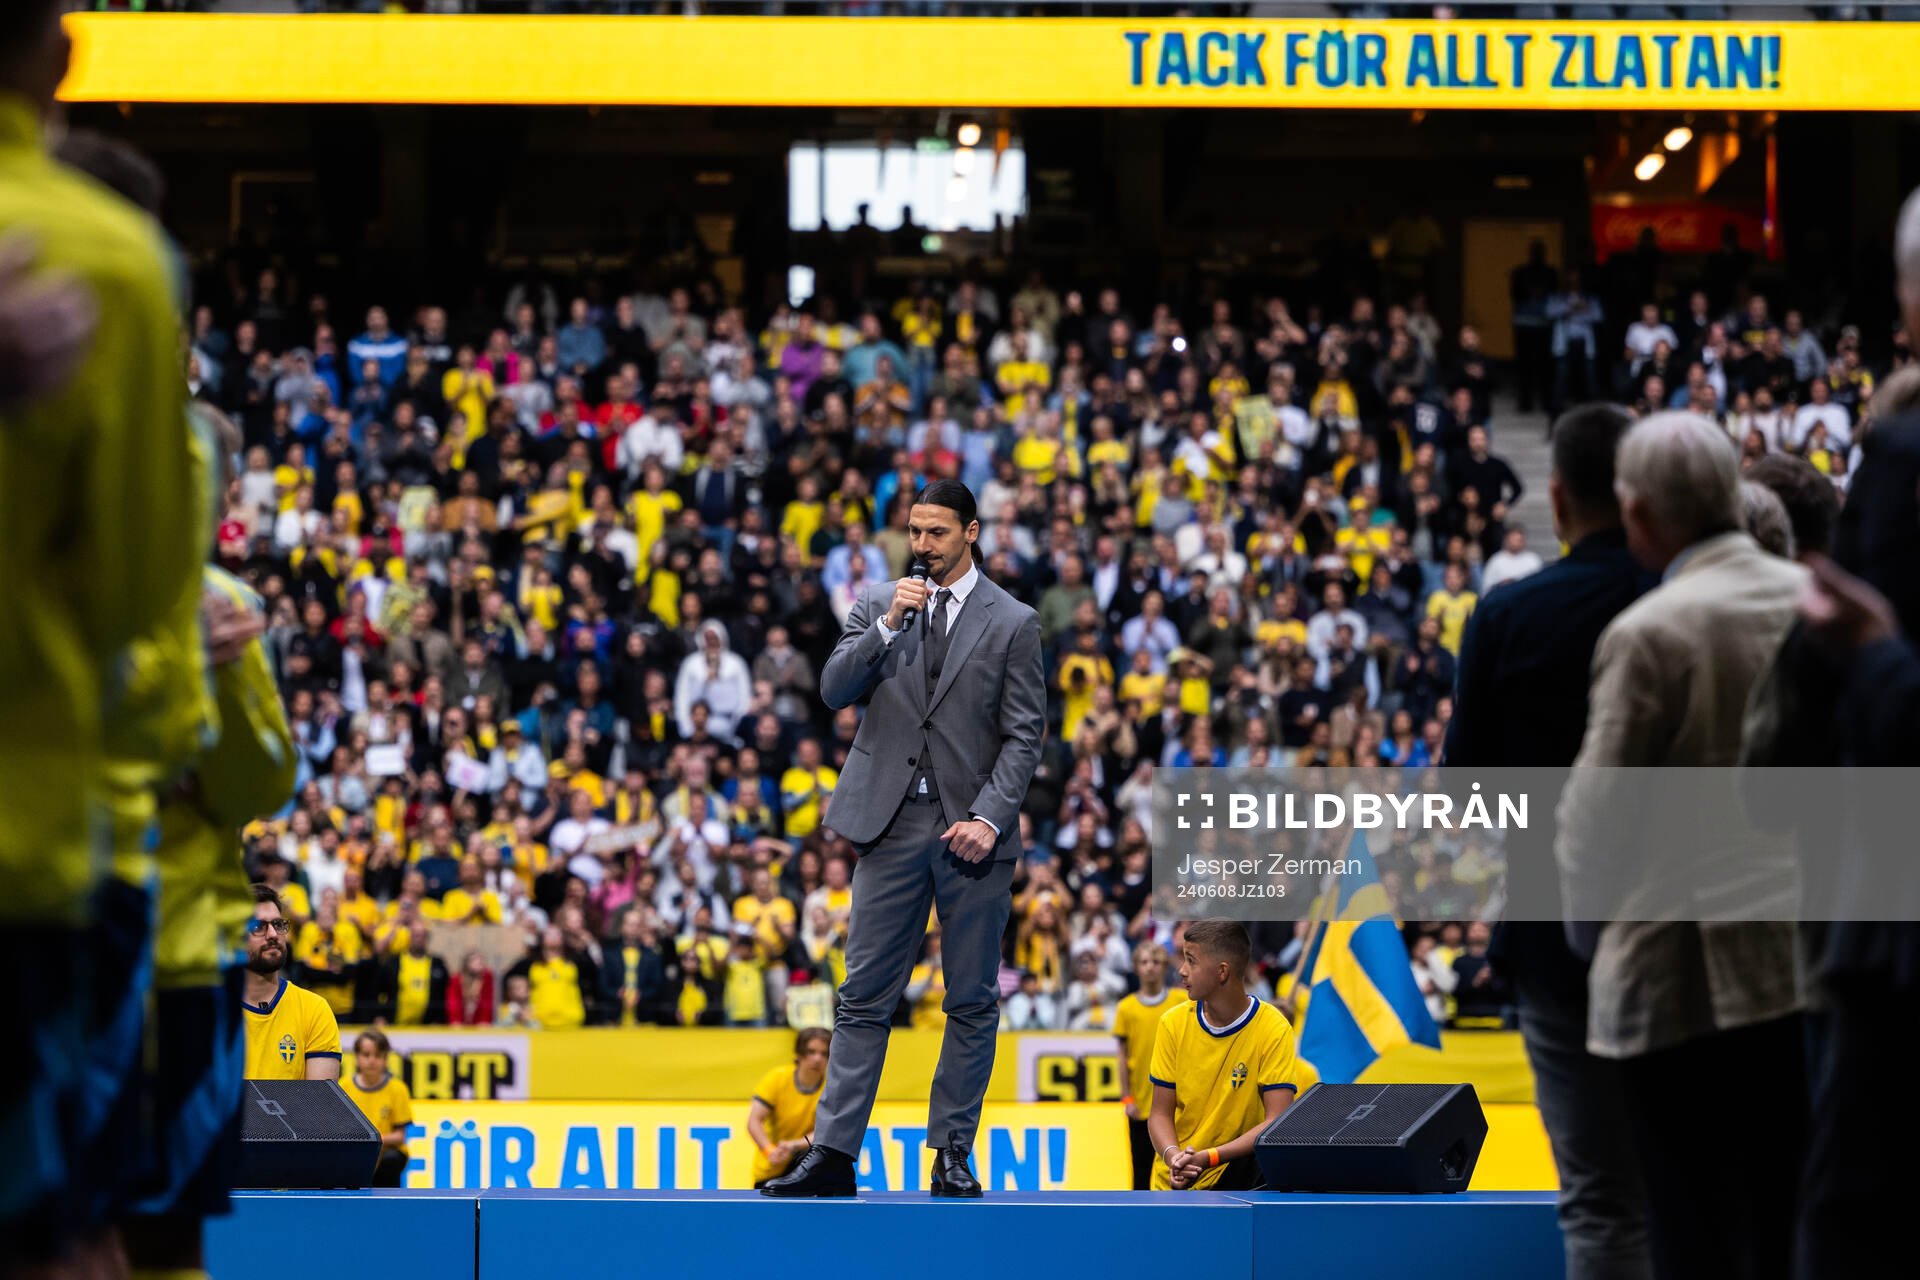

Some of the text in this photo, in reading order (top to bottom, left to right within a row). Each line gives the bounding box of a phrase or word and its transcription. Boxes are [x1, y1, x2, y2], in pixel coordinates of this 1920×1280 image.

[1124, 29, 1781, 89] TACK FÖR ALLT ZLATAN!
